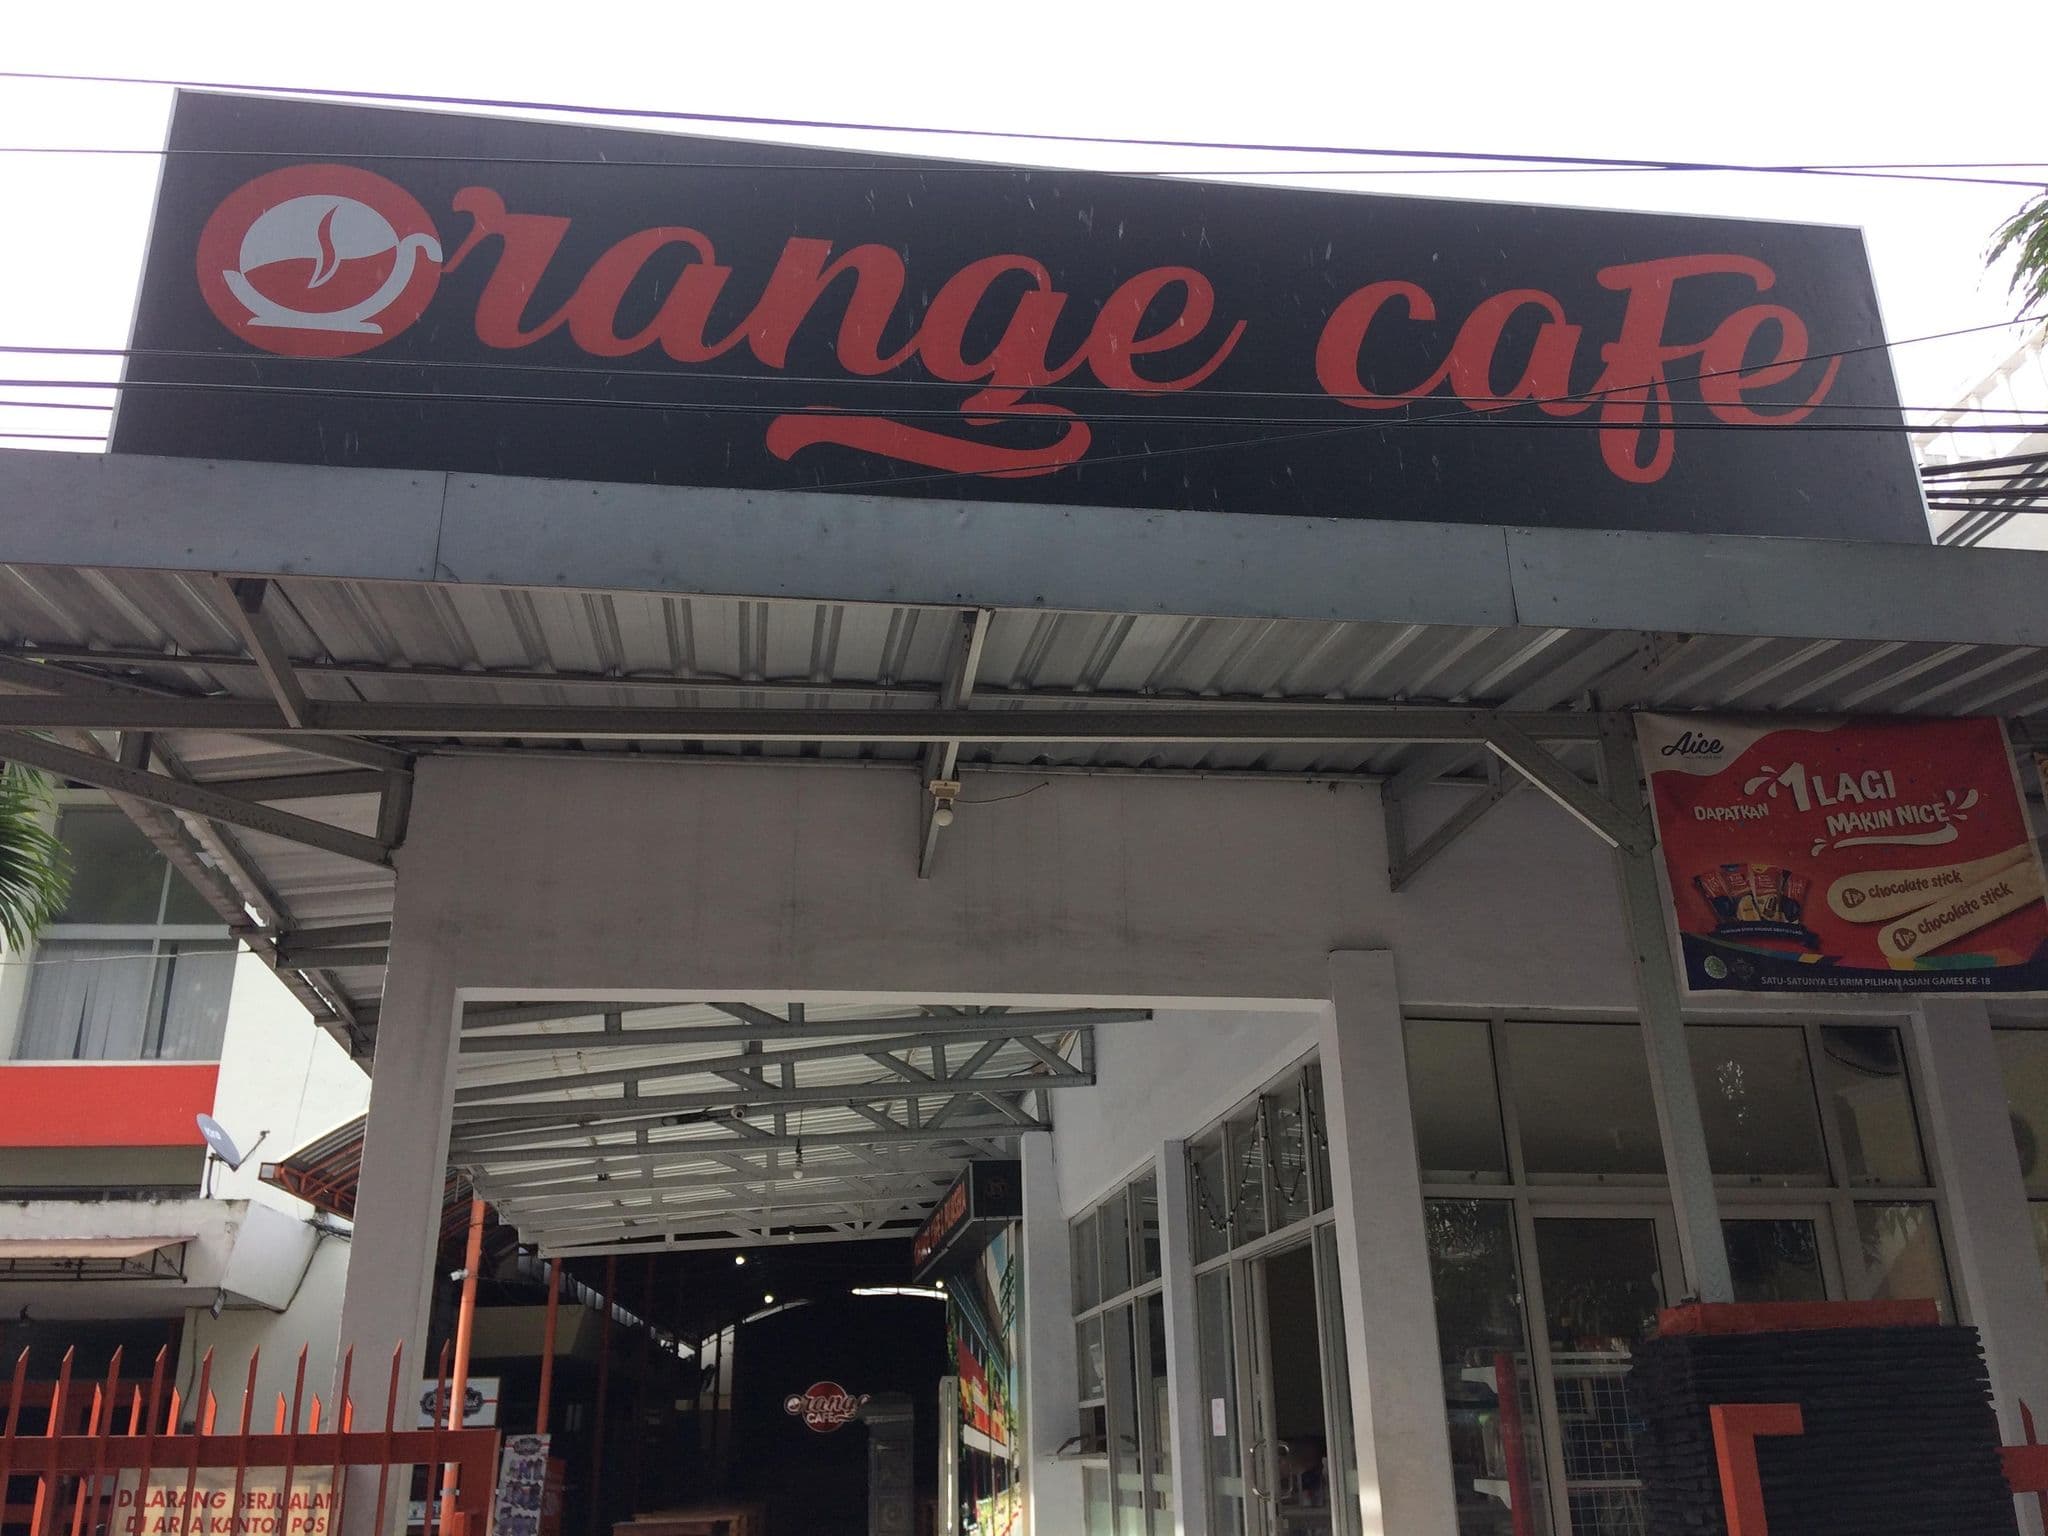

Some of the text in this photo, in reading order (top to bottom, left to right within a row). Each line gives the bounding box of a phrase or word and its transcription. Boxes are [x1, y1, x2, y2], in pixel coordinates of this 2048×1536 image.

[197, 163, 1247, 478] Orange
[1661, 731, 1724, 756] Aice
[1694, 762, 1896, 821] DAPATKAN 1 LAGI
[1826, 802, 1949, 836] MAKIN NICE
[1868, 878, 1929, 898] chocolate
[1932, 870, 1963, 887] stick
[1918, 898, 1979, 934] chocolate
[1981, 882, 2013, 906] stick
[1761, 976, 1826, 986] SATU-SATUNYA
[1840, 977, 1863, 986] KRIM
[1864, 977, 1901, 986] PILIHAN
[1902, 977, 1931, 986] ASIAN
[1932, 976, 1964, 985] GAMES
[1965, 976, 1991, 985] KE-18
[806, 1412, 834, 1423] CAFE
[152, 1515, 204, 1533] ARA
[291, 1516, 325, 1534] POS
